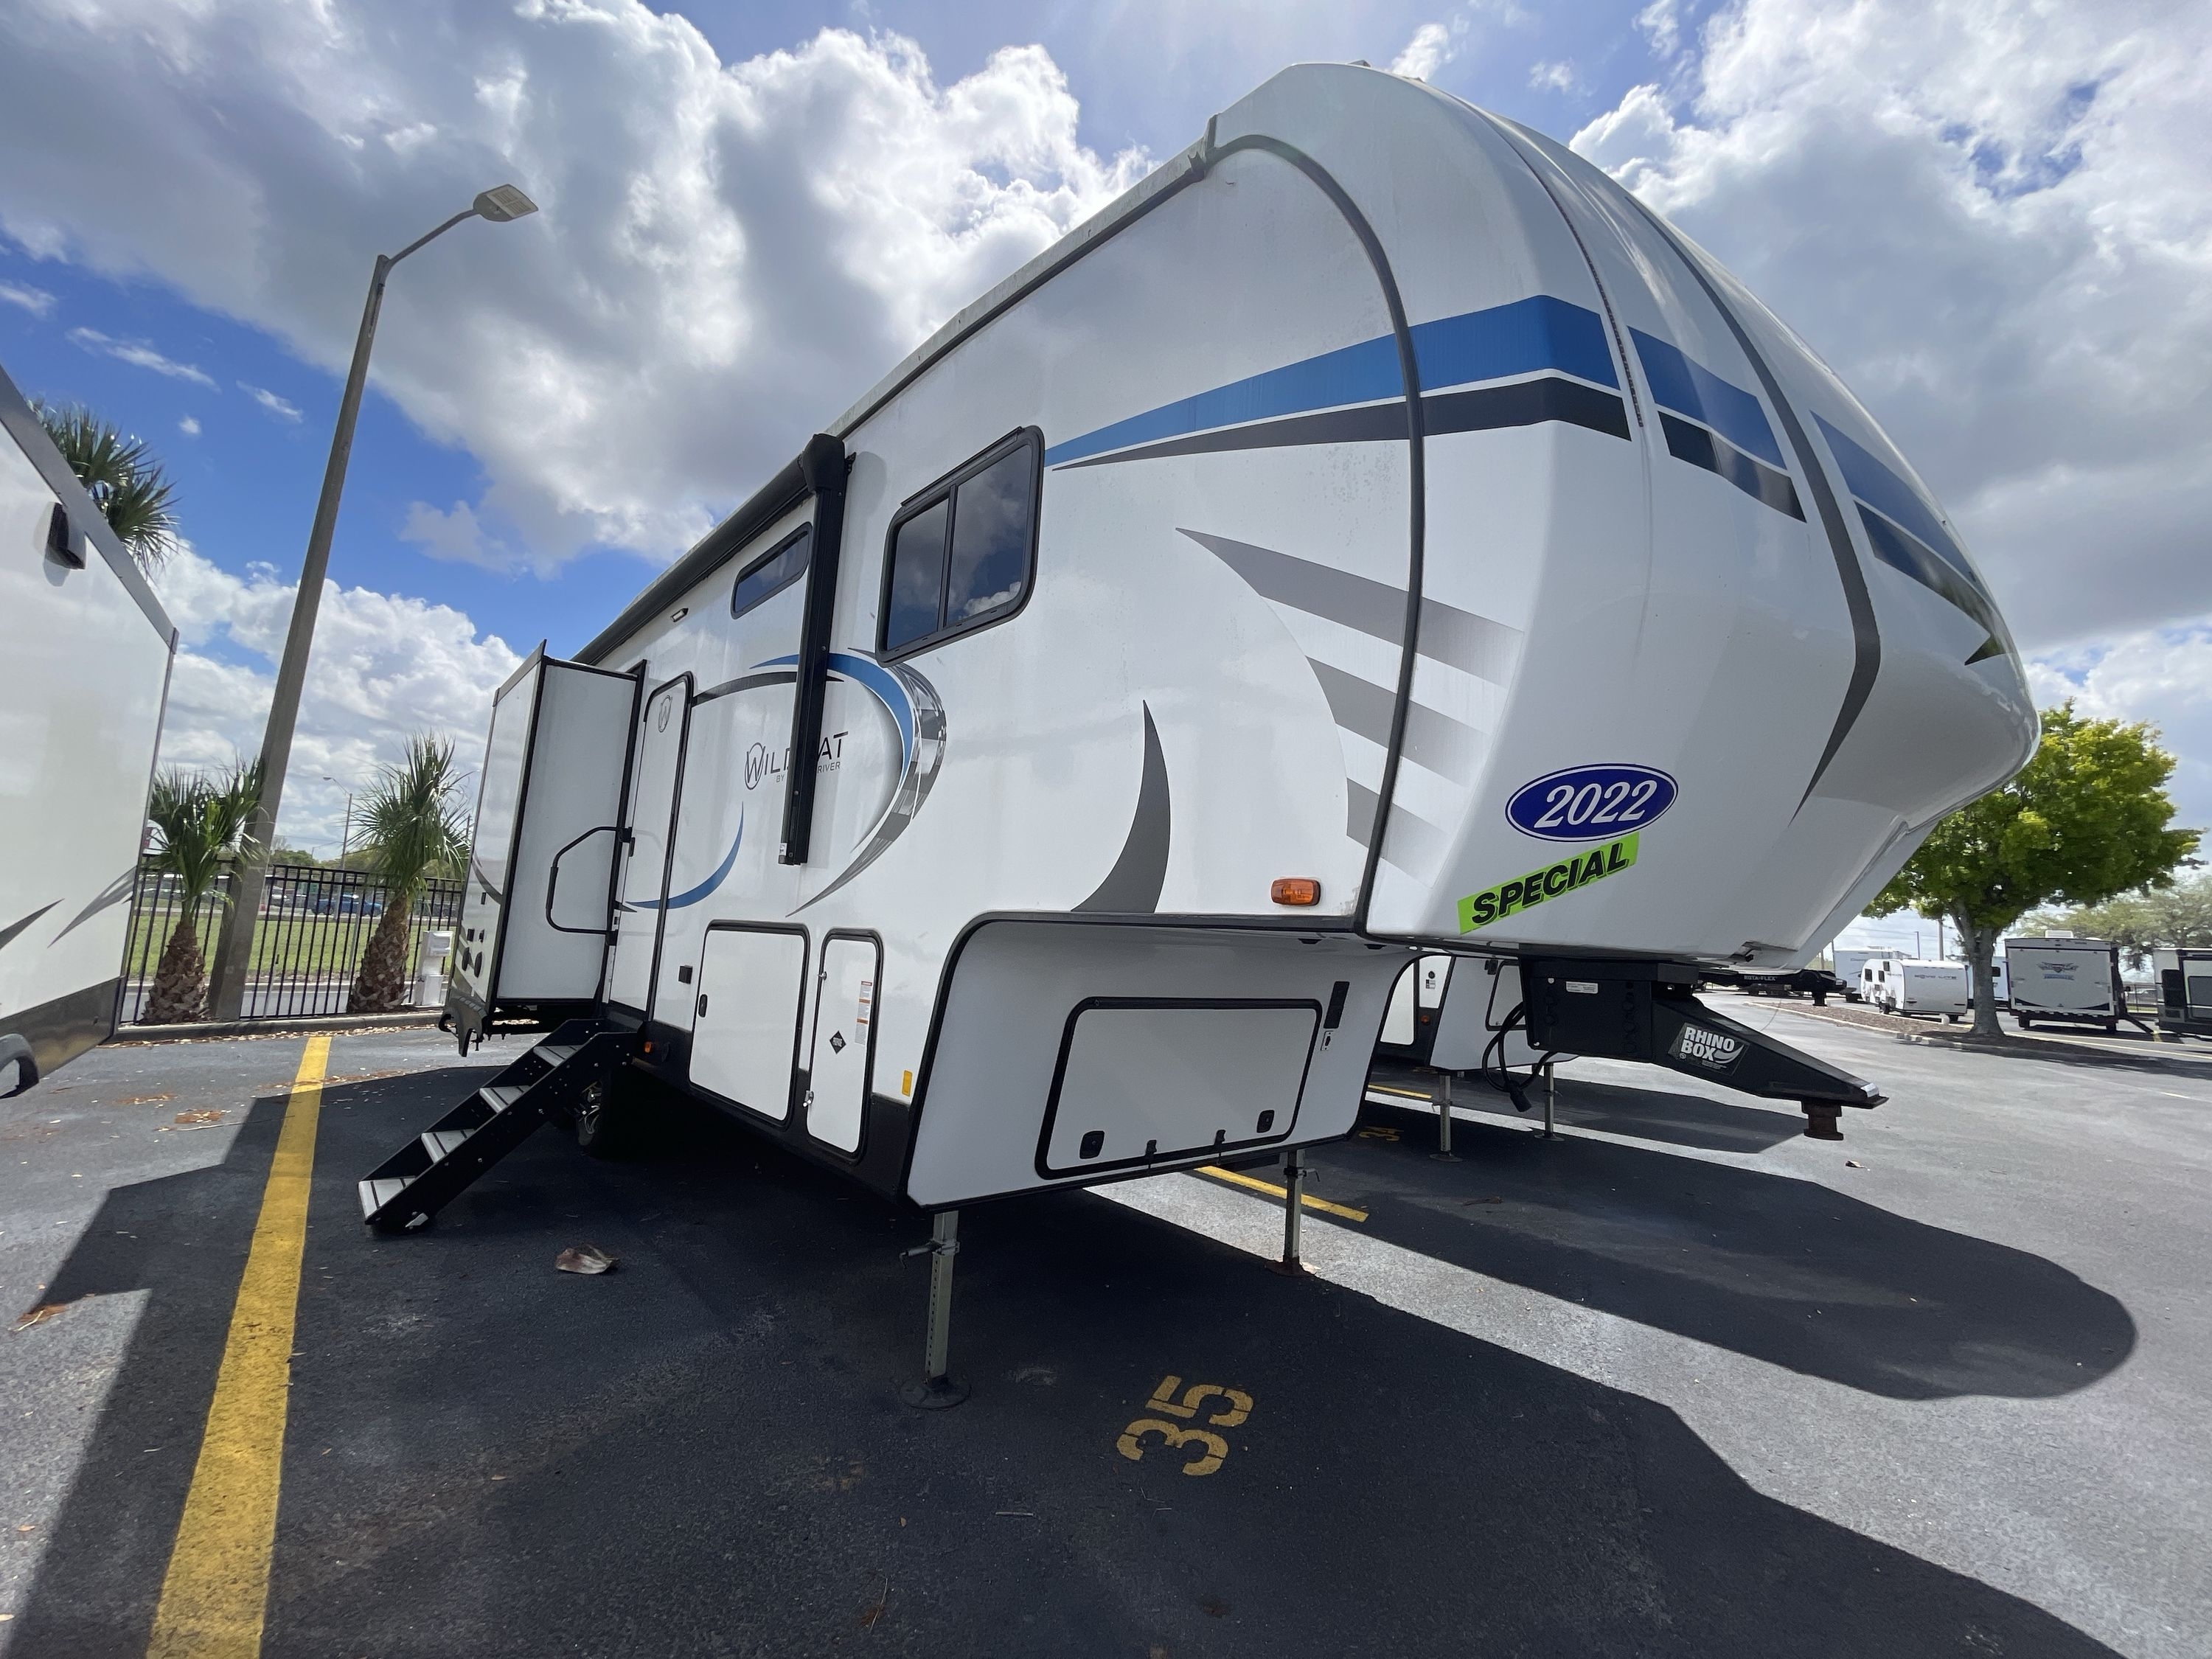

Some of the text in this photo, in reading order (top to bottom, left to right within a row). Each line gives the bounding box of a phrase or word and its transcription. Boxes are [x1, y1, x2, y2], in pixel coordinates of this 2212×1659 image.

[776, 761, 841, 783] BY RIVER
[1534, 779, 1658, 829] 2022
[1472, 842, 1630, 926] SPECIAL
[1681, 1039, 1717, 1062] BOX
[1684, 1026, 1735, 1052] RHINO
[1116, 1375, 1254, 1476] 35
